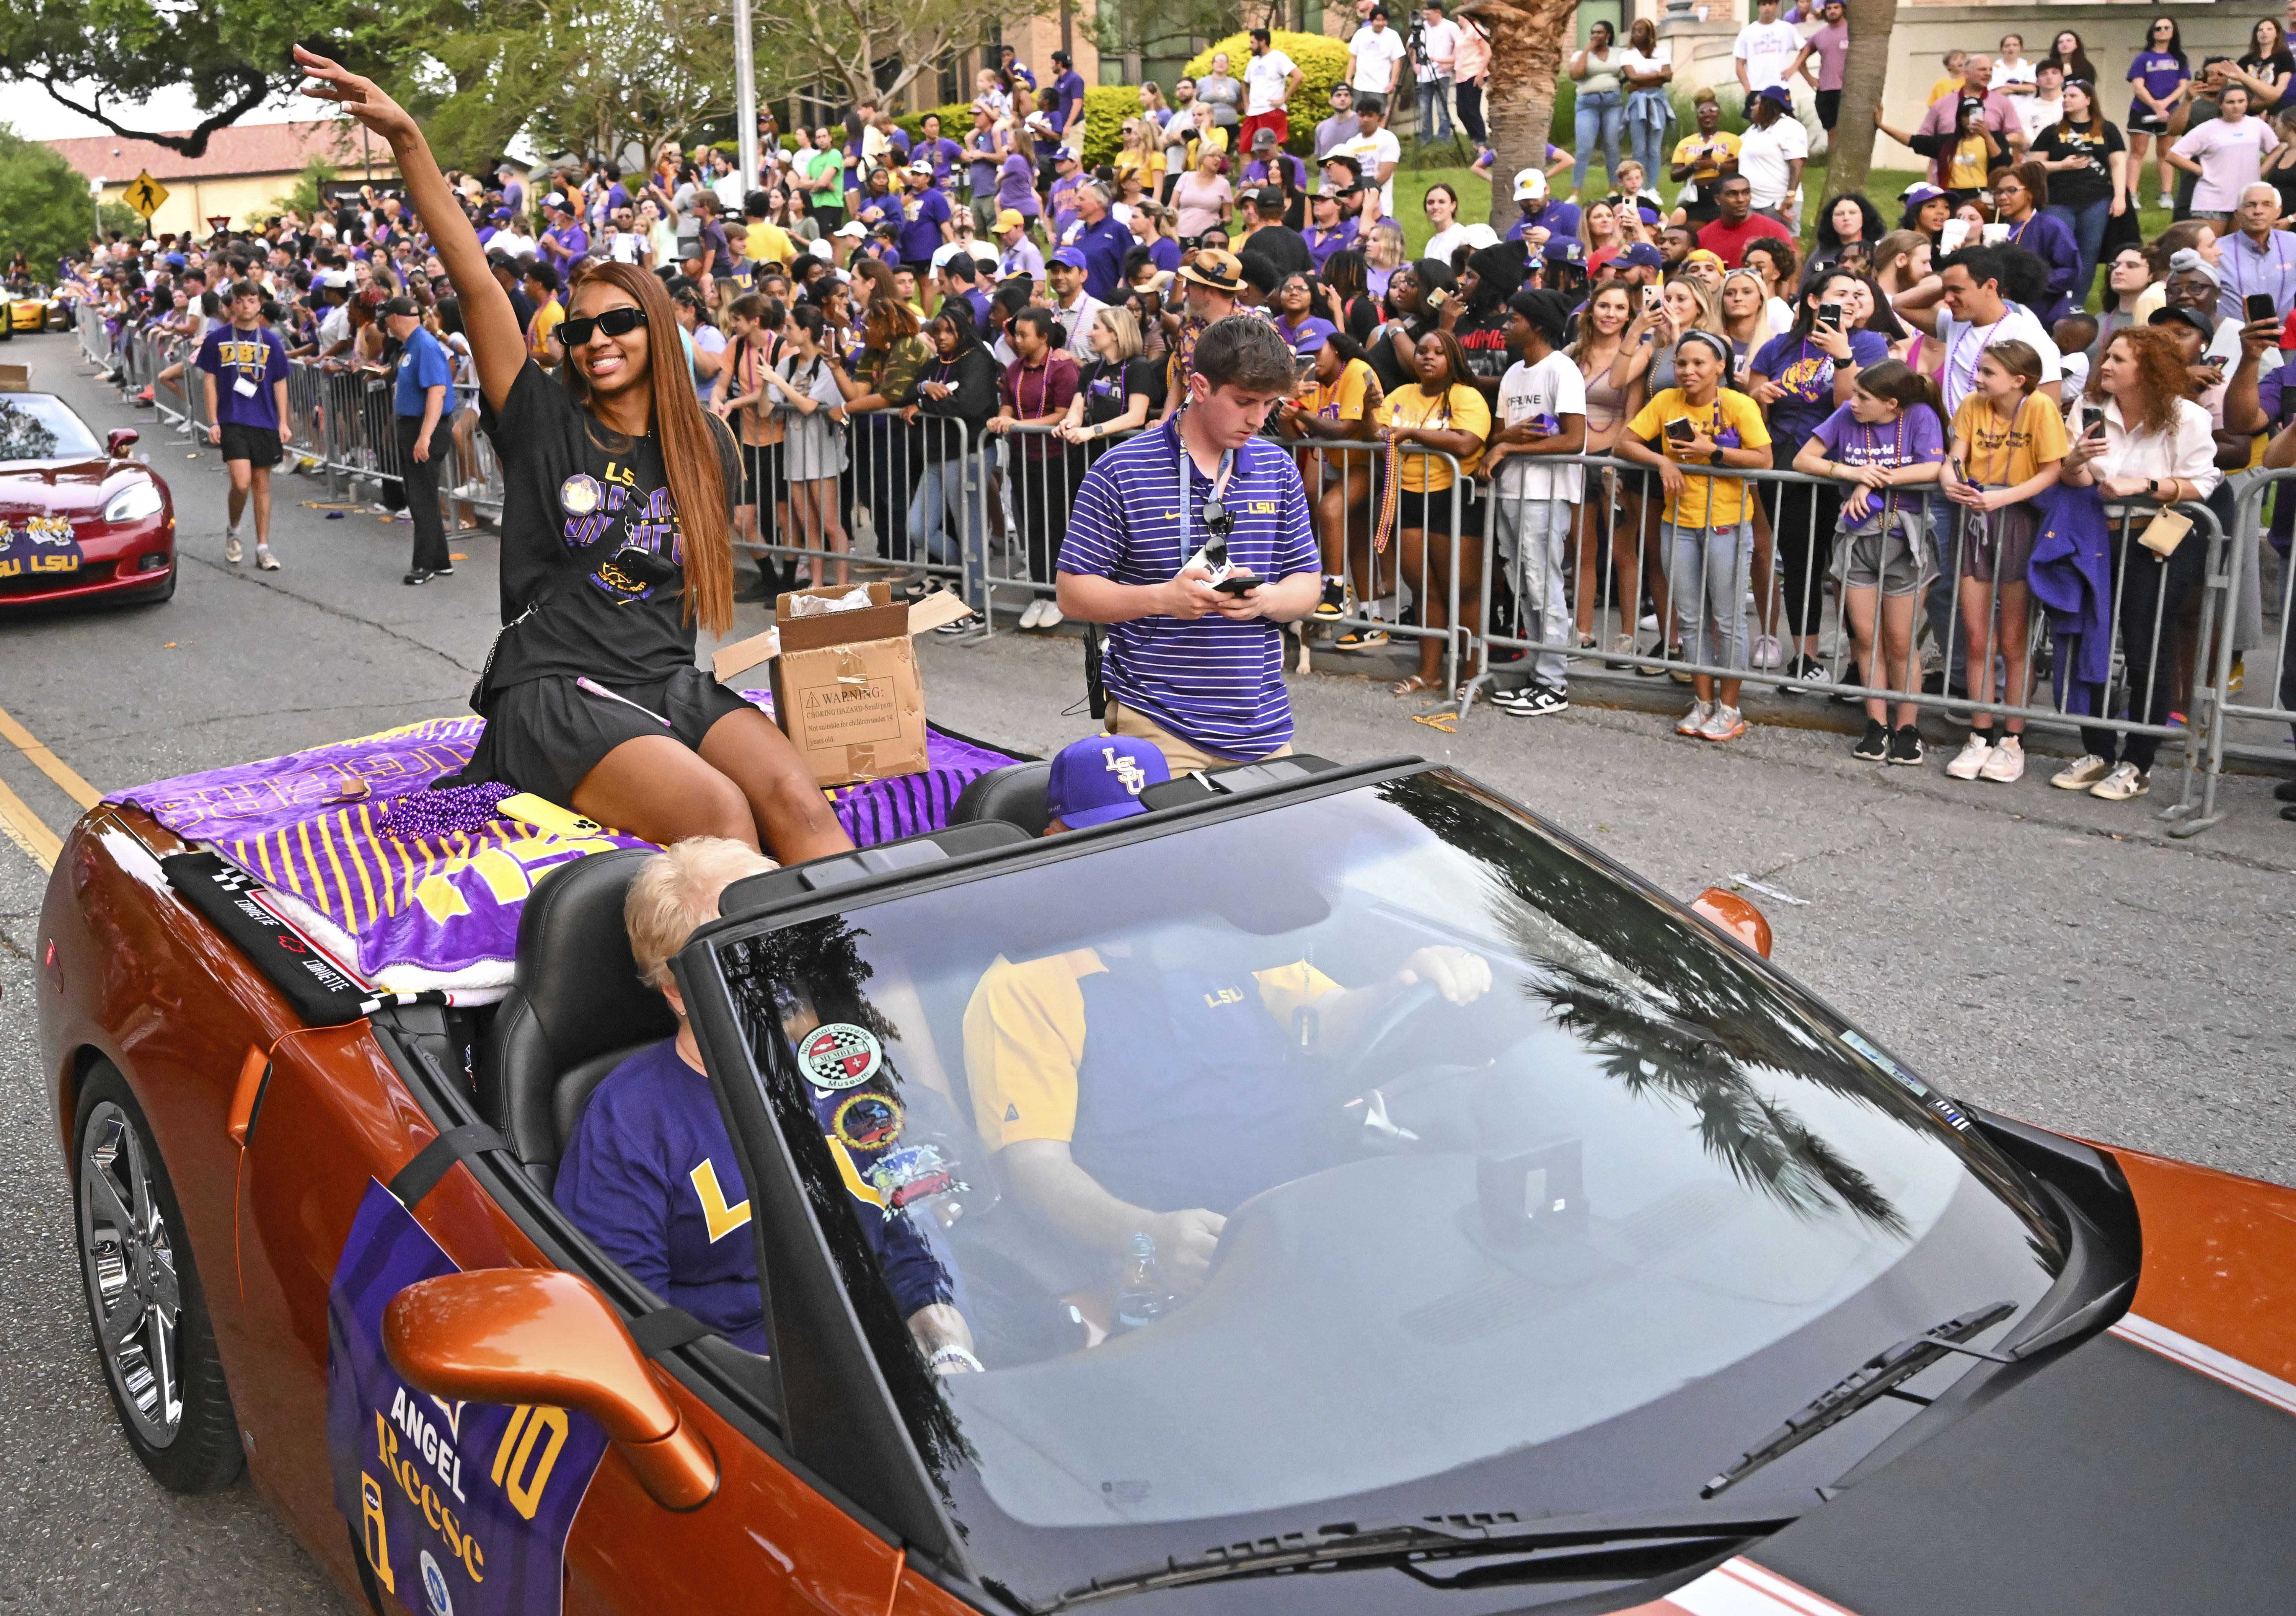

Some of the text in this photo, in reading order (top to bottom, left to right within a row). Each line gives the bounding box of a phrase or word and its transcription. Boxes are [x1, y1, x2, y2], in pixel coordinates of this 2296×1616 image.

[1248, 502, 1276, 514] LSU
[30, 555, 78, 571] LSU
[822, 687, 884, 705] WARNING:
[806, 711, 835, 719] CHOKING
[881, 701, 894, 710] parts
[819, 722, 840, 730] suitable
[849, 718, 870, 726] children
[810, 737, 824, 746] years
[1102, 747, 1145, 795] LSU
[234, 900, 280, 926] CORVETTE
[302, 959, 350, 992] CORVETTE
[1203, 984, 1244, 1008] LSU
[801, 1024, 871, 1054] National Corvette
[820, 1047, 859, 1062] MEMBER
[828, 1071, 870, 1087] Museum
[391, 1386, 465, 1504] ANGEL
[491, 1404, 569, 1520] 10
[375, 1407, 483, 1583] Reese
